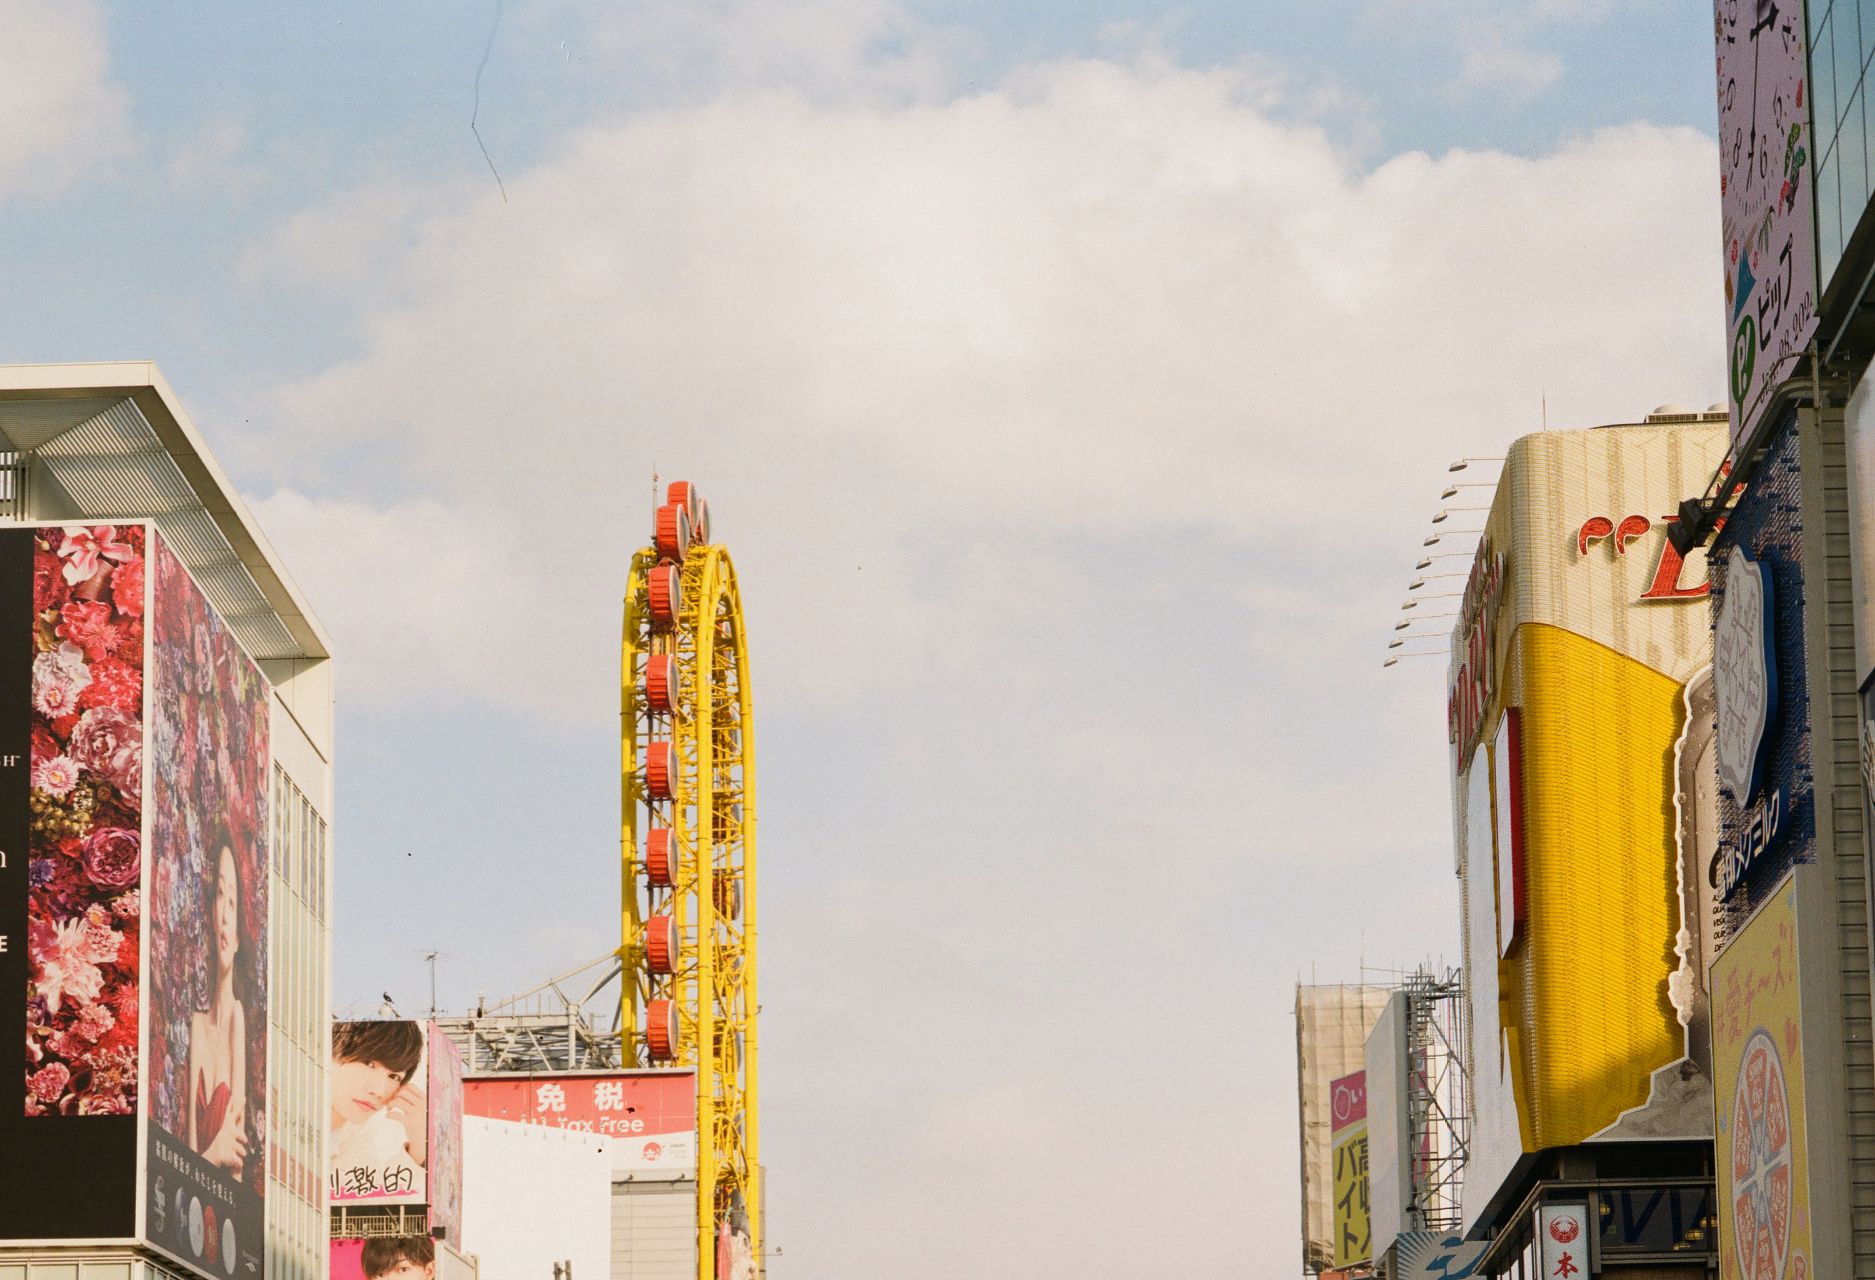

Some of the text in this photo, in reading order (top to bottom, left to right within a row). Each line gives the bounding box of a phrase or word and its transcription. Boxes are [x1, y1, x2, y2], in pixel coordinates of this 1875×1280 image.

[1758, 233, 1794, 352] ピップ
[536, 1081, 625, 1113] 免税
[600, 1117, 644, 1134] Free
[1336, 1140, 1359, 1260] バイト
